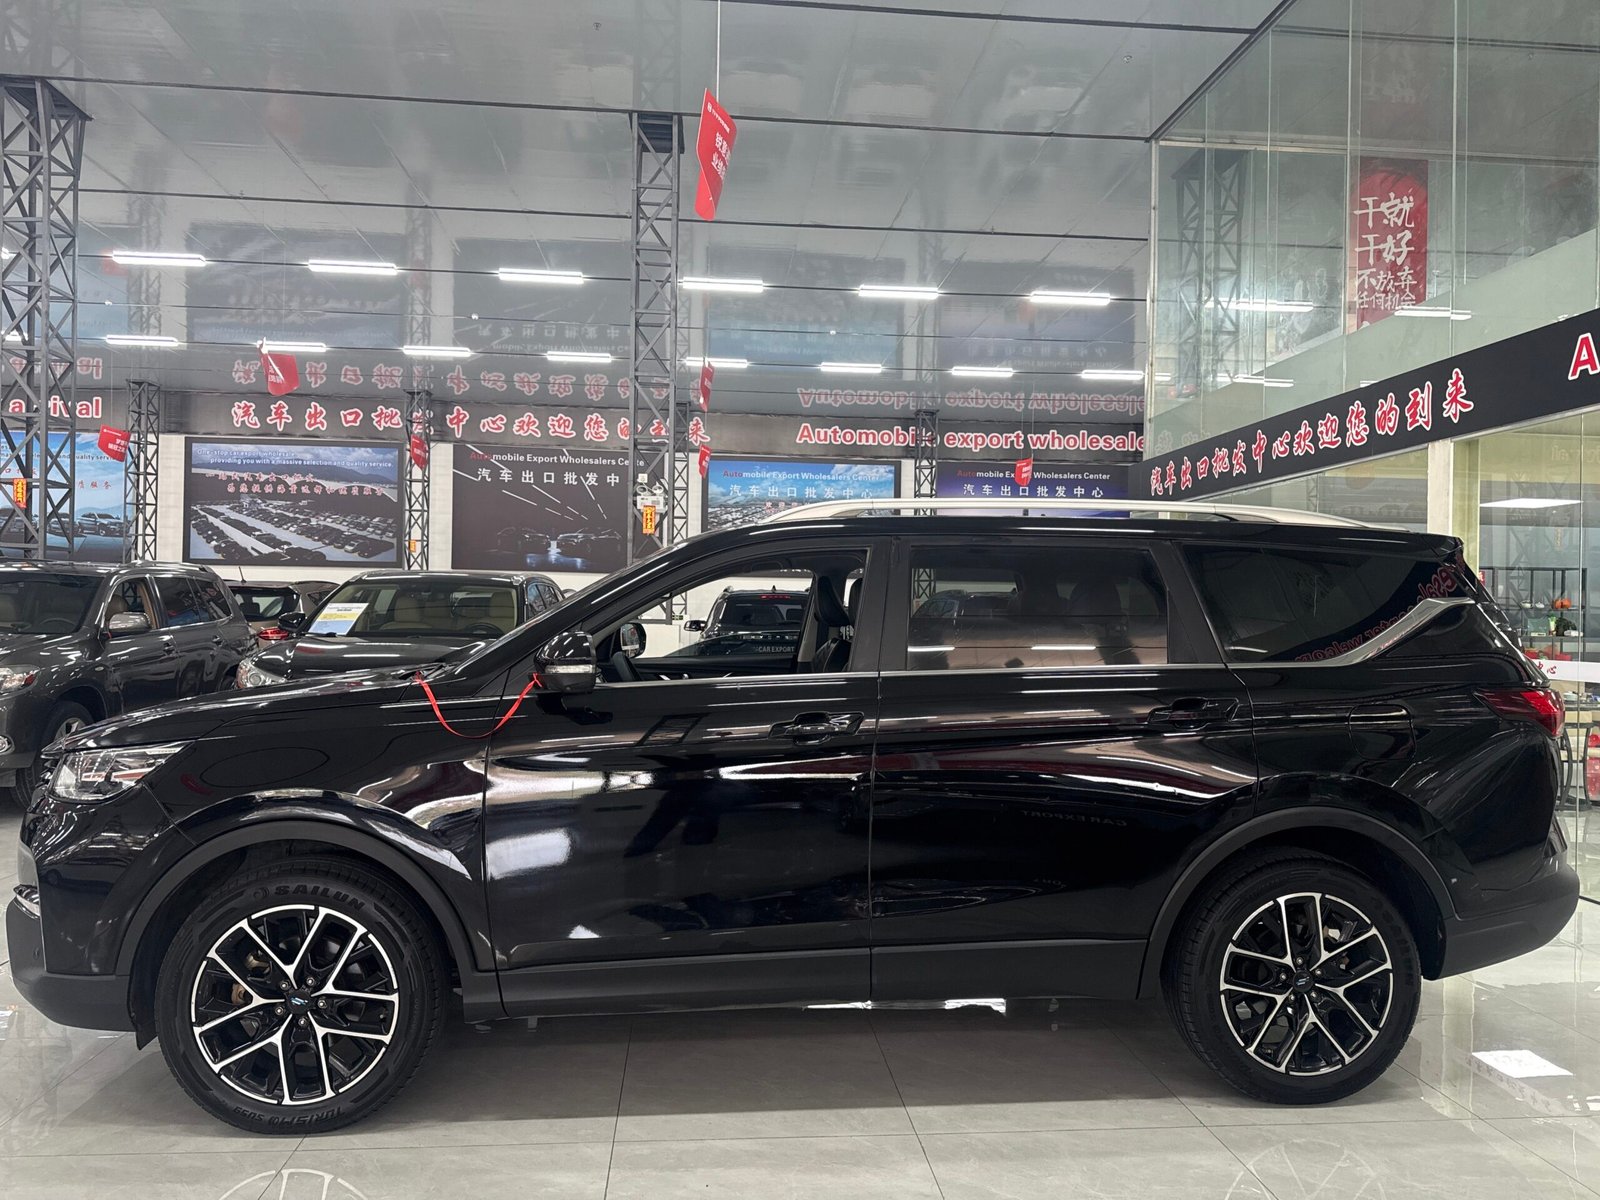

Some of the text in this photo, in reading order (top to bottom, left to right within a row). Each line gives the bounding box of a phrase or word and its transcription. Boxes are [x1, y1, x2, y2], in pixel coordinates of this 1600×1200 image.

[1354, 229, 1415, 266] 干好
[1356, 265, 1418, 293] 不放弃
[944, 427, 1025, 451] export
[1150, 367, 1474, 497] 汽车出口批发中心欢迎您的到来
[75, 453, 96, 461] uality
[527, 453, 558, 464] Export
[560, 455, 616, 466] Wholesalers
[723, 469, 771, 479] Automobile
[772, 471, 800, 480] Export
[801, 472, 850, 481] Wholesalers
[1034, 471, 1082, 480] Wholesalers
[1083, 472, 1111, 480] Center
[729, 484, 873, 499] 汽车出口批发中心
[963, 483, 1104, 498] 汽车出口批发中心
[274, 884, 365, 911] SAILUN
